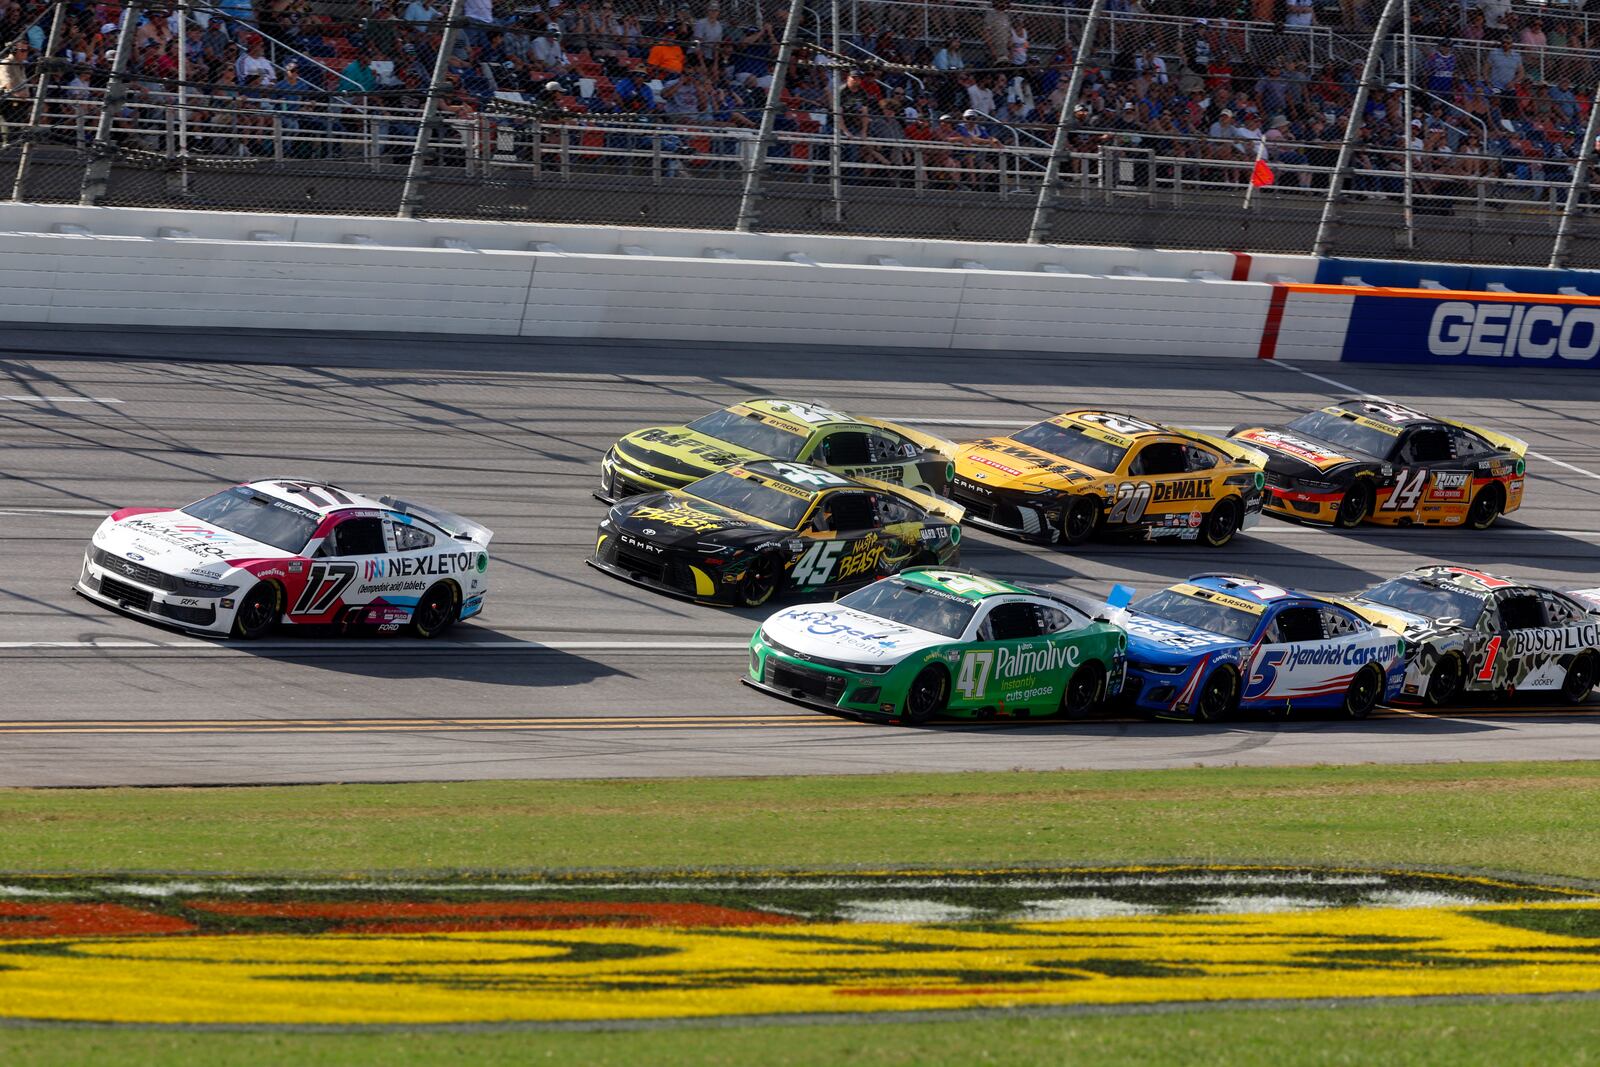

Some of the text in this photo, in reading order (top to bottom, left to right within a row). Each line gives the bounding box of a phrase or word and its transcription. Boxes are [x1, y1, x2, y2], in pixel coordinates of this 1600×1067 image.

[1428, 301, 1600, 360] GEICO
[769, 419, 800, 432] BYRON
[1103, 434, 1125, 446] BELL
[772, 481, 811, 498] REDDICK
[953, 478, 993, 496] CAMRY
[1381, 469, 1427, 512] 14
[1435, 472, 1467, 490] RUSH
[273, 501, 321, 521] BUESCHER
[1107, 481, 1152, 524] 20
[919, 526, 949, 540] HARD TEA
[620, 535, 664, 554] CAMRY
[388, 552, 476, 577] NEXLETOL
[791, 541, 846, 585] 45
[836, 545, 885, 581] BEAST
[291, 561, 360, 615] 17
[403, 581, 426, 591] tablets
[1439, 583, 1486, 601] CHASTAIN
[925, 588, 966, 604] STENHOUSE
[1216, 596, 1254, 611] LARSON
[1514, 628, 1563, 655] BUSCH
[994, 639, 1081, 680] Palmolive
[1212, 652, 1238, 664] GOODYEAR
[1476, 635, 1502, 681] 1
[956, 650, 994, 700] 47
[1241, 650, 1287, 699] 5
[1006, 686, 1053, 702] cuts grease
